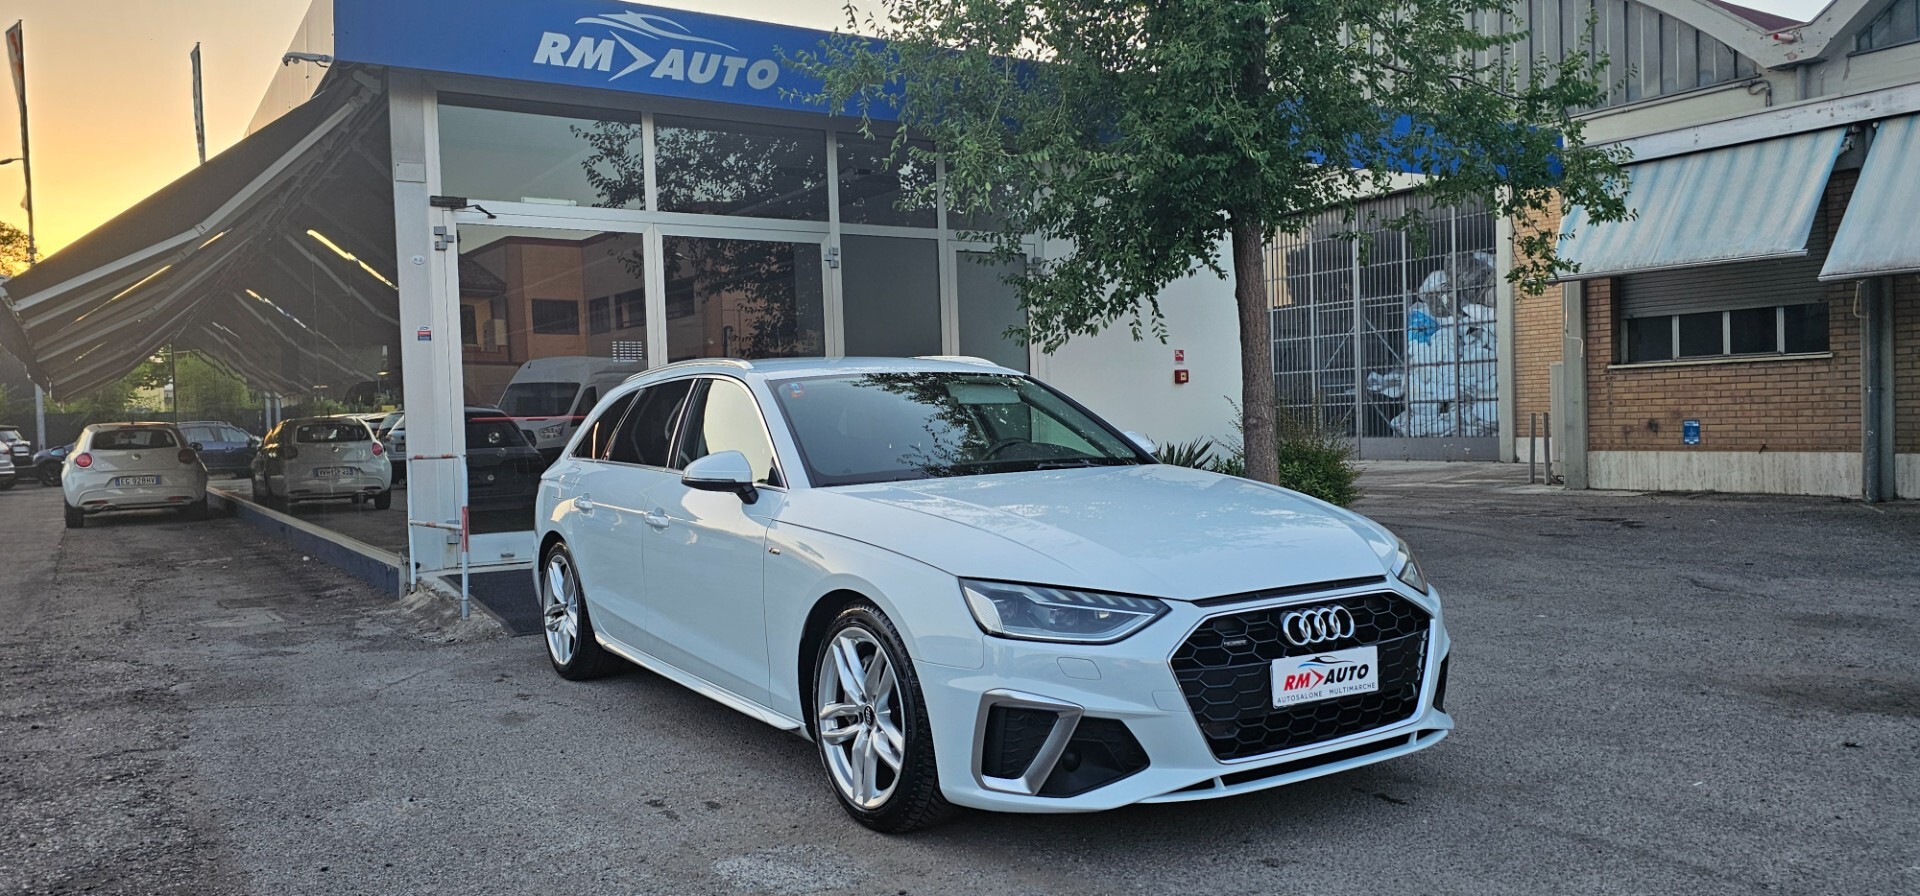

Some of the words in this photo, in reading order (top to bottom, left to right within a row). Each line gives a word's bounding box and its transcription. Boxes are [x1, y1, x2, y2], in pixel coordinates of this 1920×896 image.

[533, 31, 615, 72] RM
[650, 48, 779, 90] AUTO
[1323, 664, 1369, 685] AUTO
[1277, 691, 1322, 703] AUTOSALONE
[1329, 682, 1376, 695] MULTIMARCHE
